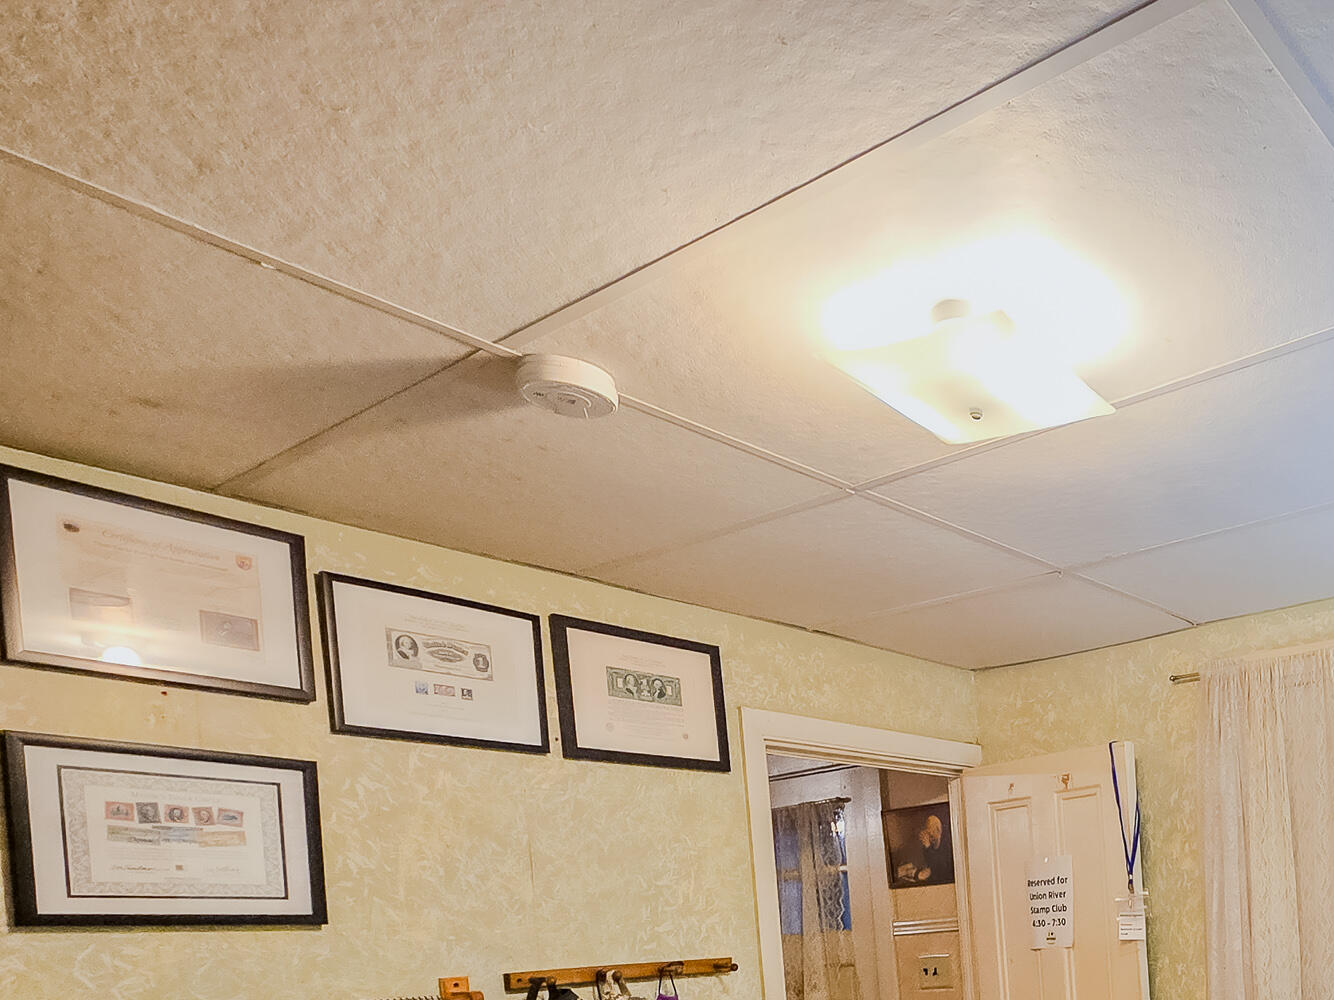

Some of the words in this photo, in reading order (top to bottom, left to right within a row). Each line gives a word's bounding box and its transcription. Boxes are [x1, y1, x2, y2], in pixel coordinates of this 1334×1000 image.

[1027, 877, 1055, 888] Reserved
[1057, 875, 1068, 885] for
[1029, 891, 1047, 901] Union
[1048, 890, 1066, 899] River
[1030, 905, 1050, 915] Stamp
[1051, 903, 1067, 913] Club
[1051, 917, 1067, 927] 7:30
